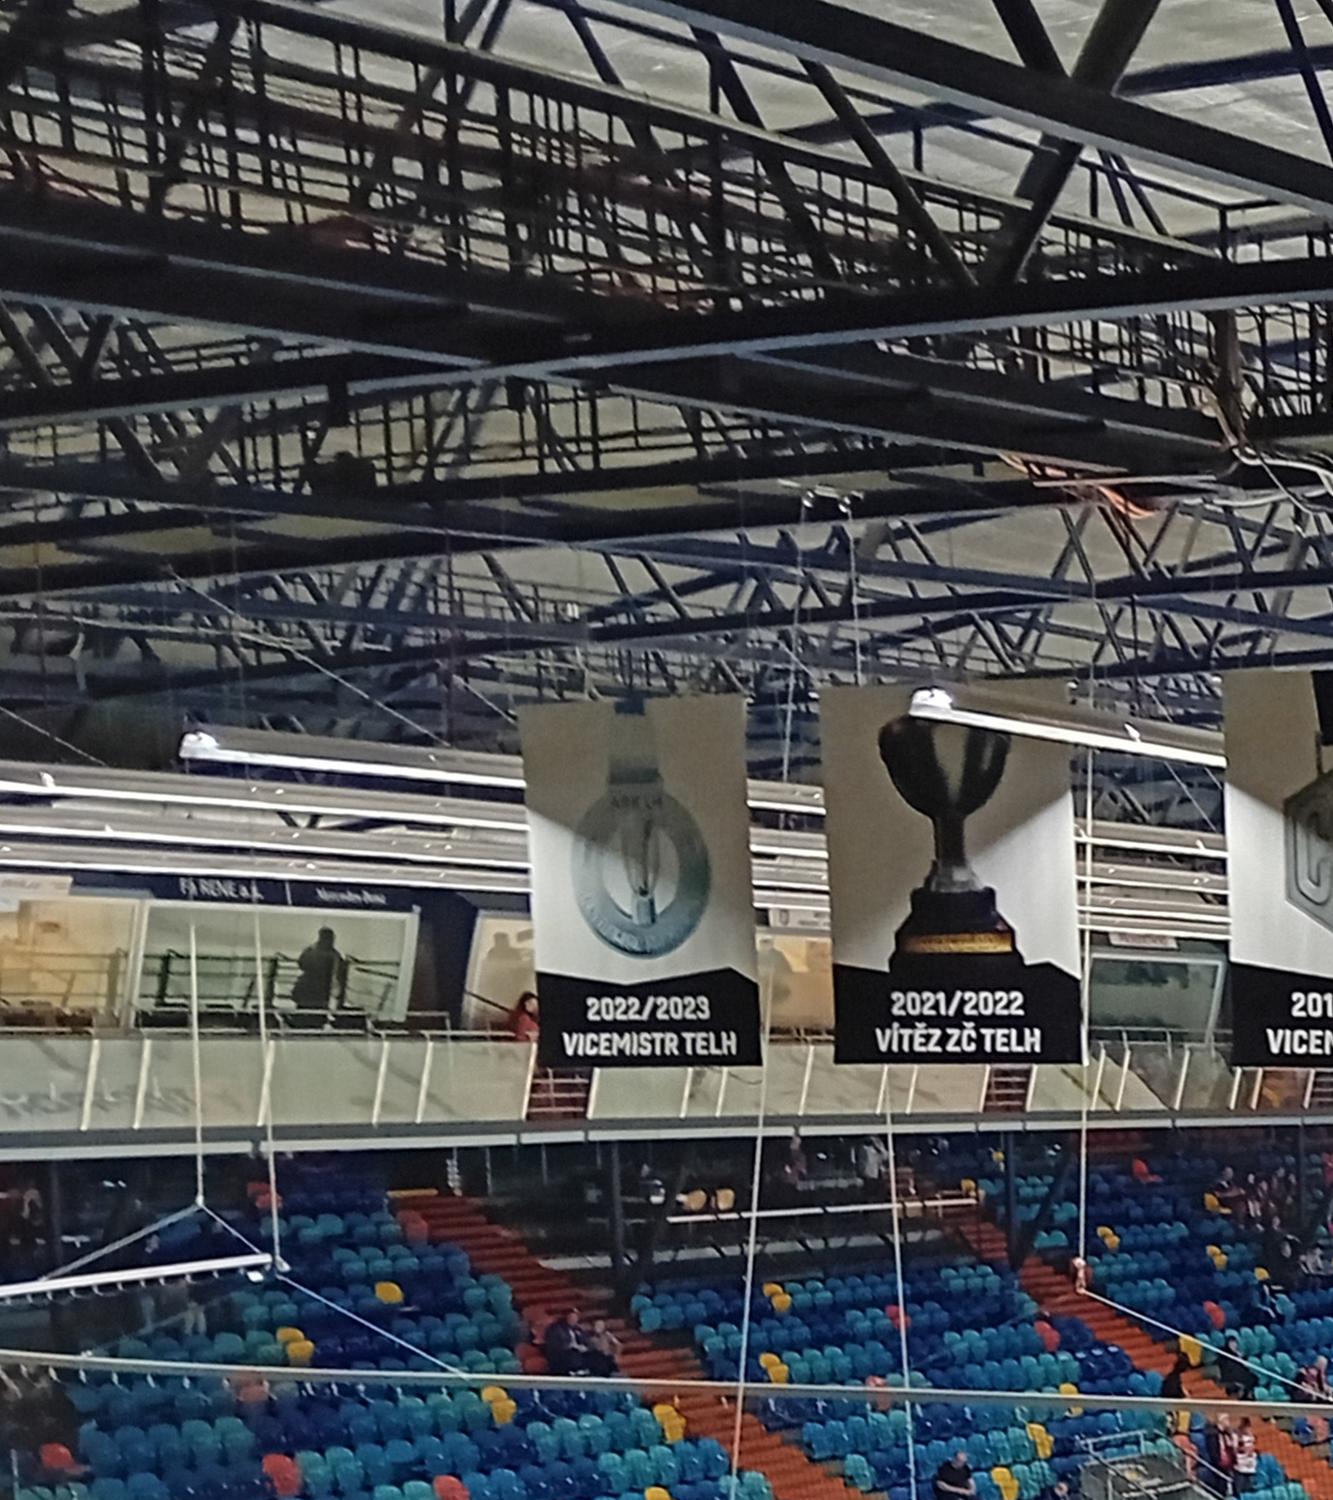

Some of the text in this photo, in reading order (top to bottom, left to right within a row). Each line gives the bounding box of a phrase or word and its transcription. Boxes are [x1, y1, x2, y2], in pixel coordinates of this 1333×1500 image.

[586, 996, 710, 1021] 2022/2023
[890, 990, 1025, 1017] 2021/2022
[562, 1031, 737, 1057] VICEMISTR TELH
[875, 1021, 1042, 1053] VÍTĚZ ZČ TELH
